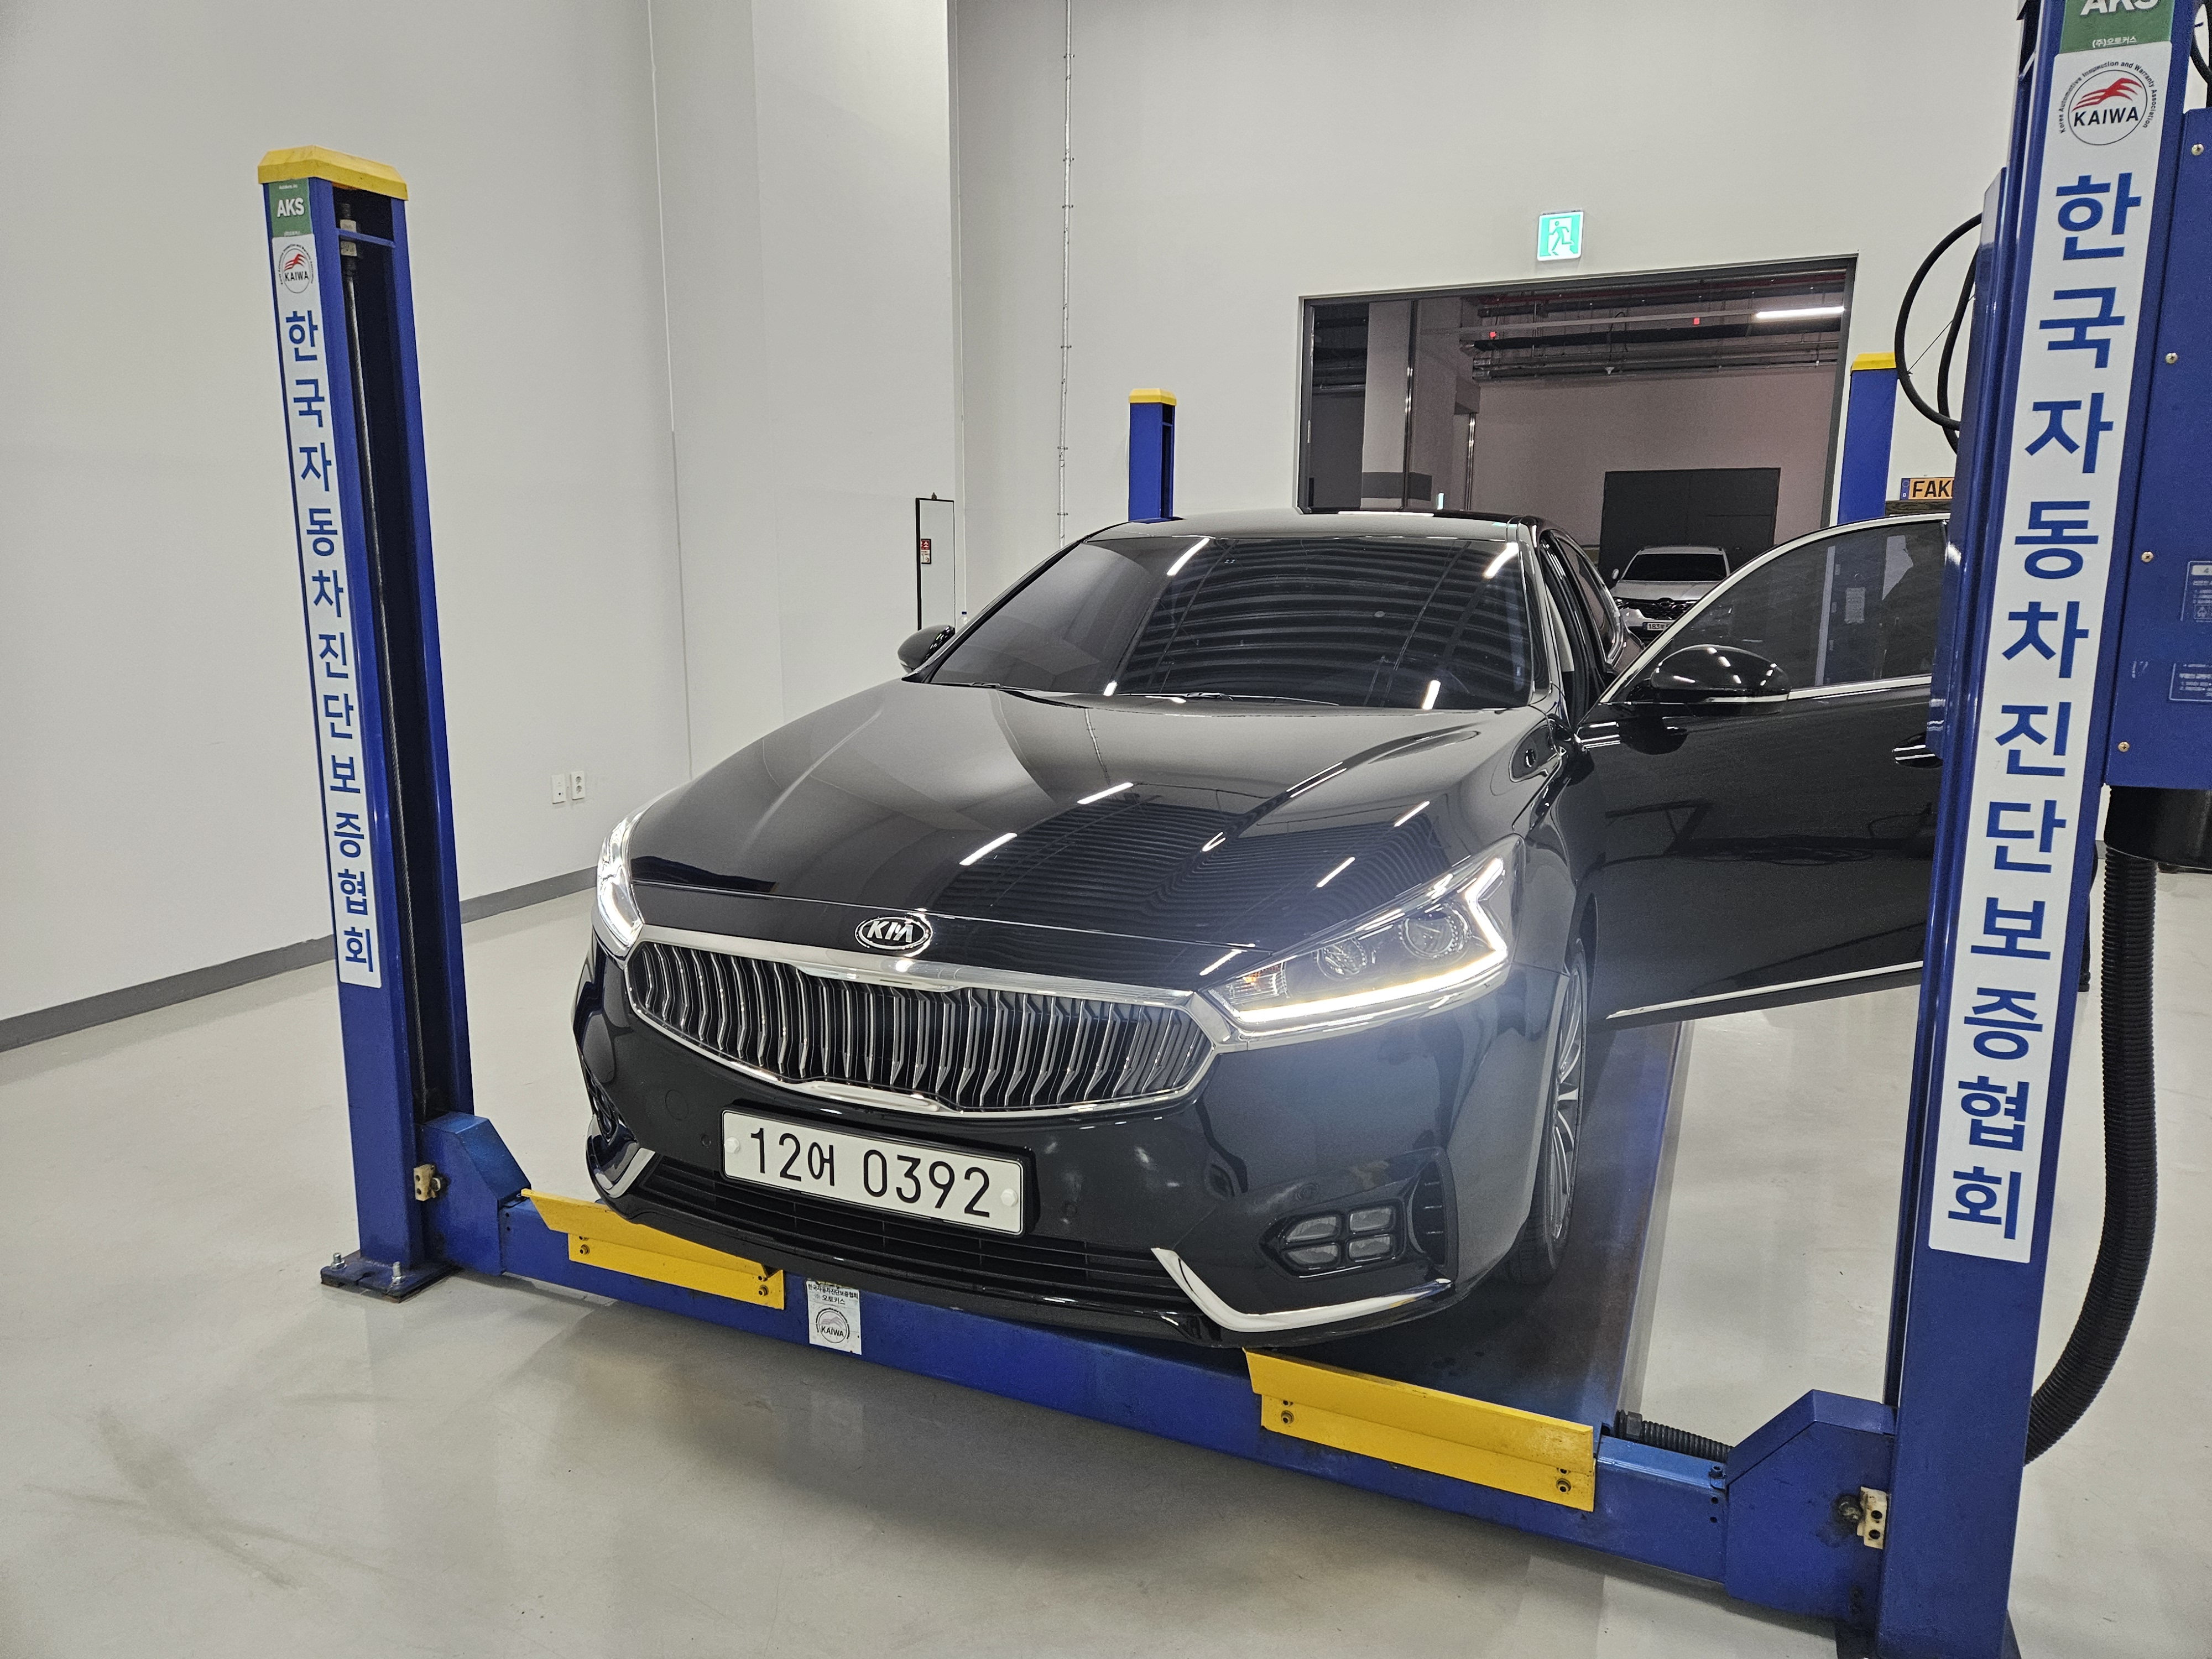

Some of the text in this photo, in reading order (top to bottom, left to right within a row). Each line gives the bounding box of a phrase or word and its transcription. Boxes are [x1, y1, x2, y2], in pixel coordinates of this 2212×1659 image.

[2135, 64, 2154, 87] Warranty
[2074, 106, 2139, 127] KAIWA
[2142, 90, 2157, 128] Association
[277, 197, 305, 218] AKS
[284, 270, 310, 282] KAIWA
[867, 921, 914, 943] KIA
[750, 1128, 990, 1218] 12어 0392
[821, 1326, 844, 1337] KAIWA
